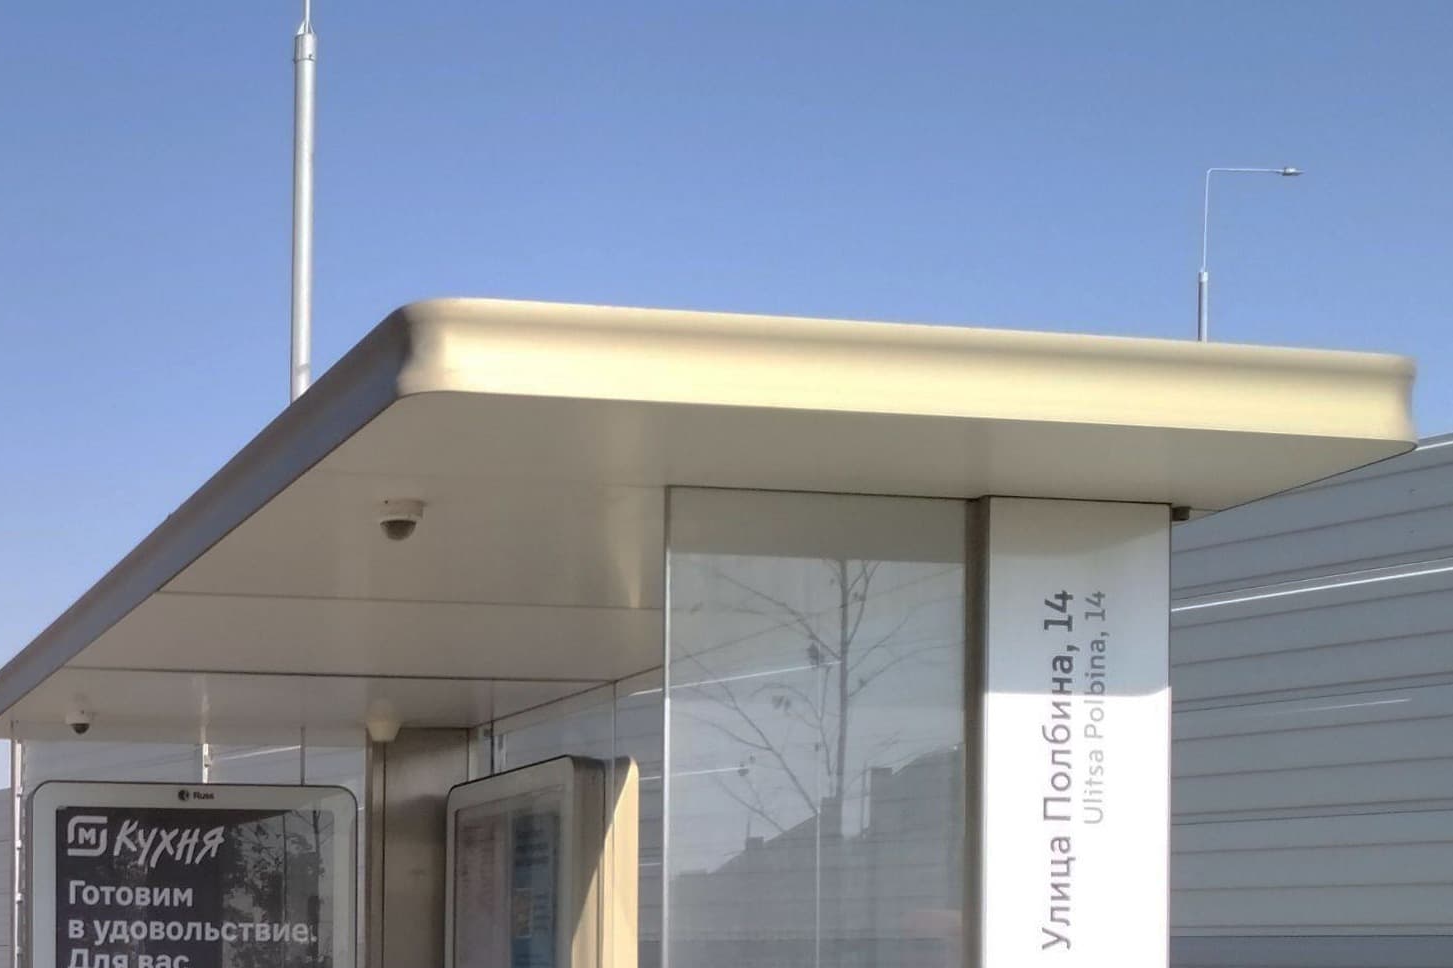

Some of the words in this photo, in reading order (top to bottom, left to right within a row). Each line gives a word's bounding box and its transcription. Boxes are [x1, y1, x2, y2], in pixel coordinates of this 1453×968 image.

[1043, 589, 1074, 632] 14
[1084, 590, 1106, 623] 14
[1083, 630, 1110, 740] Polbina,
[1041, 645, 1080, 822] Полбина,
[1083, 748, 1105, 825] Ulitsa
[68, 880, 194, 907] Готовим
[1041, 835, 1076, 950] Улица
[68, 919, 85, 940] в
[93, 919, 318, 946] удовольствие.
